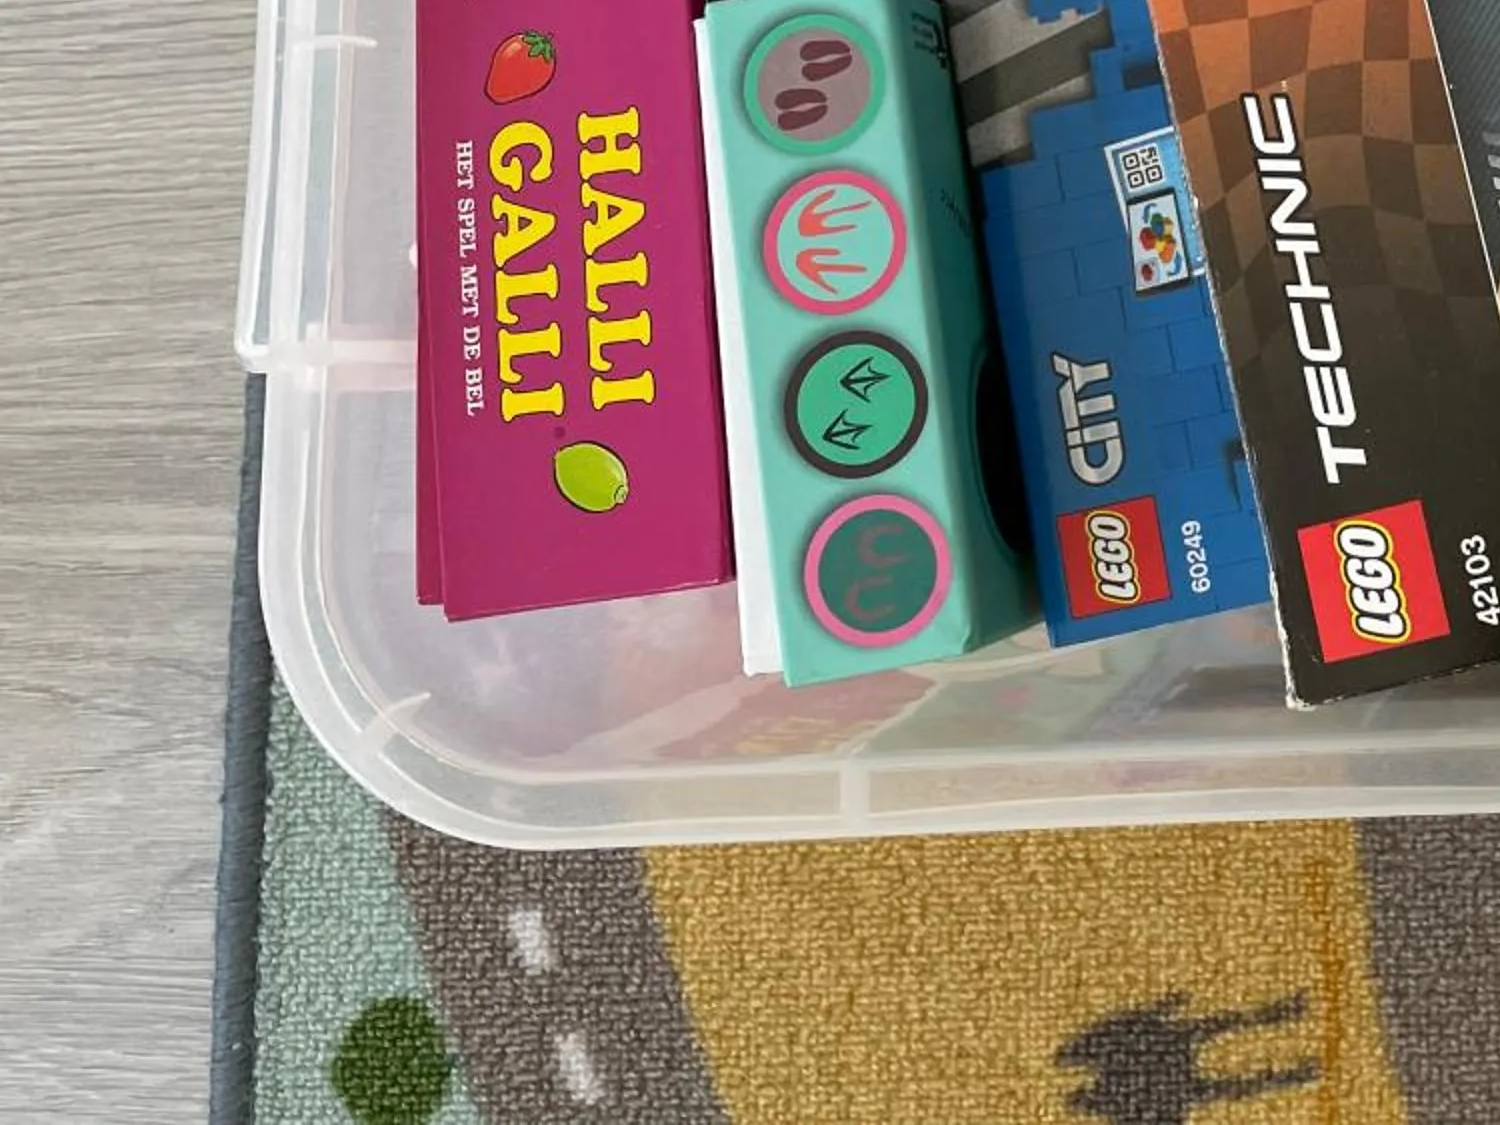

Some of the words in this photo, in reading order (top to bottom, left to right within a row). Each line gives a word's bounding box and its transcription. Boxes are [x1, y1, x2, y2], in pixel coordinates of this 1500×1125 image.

[456, 140, 475, 191] HET
[456, 197, 478, 258] SPEL
[577, 104, 656, 411] HALLI
[460, 264, 479, 319] MET
[488, 120, 565, 423] GALLI
[1243, 93, 1368, 484] TECHNIC
[463, 326, 481, 361] DE
[464, 367, 484, 418] BEL
[1087, 512, 1138, 602] LEGO
[1180, 520, 1211, 593] 60249
[1336, 521, 1410, 642] LEGO
[1461, 534, 1500, 627] 42103
